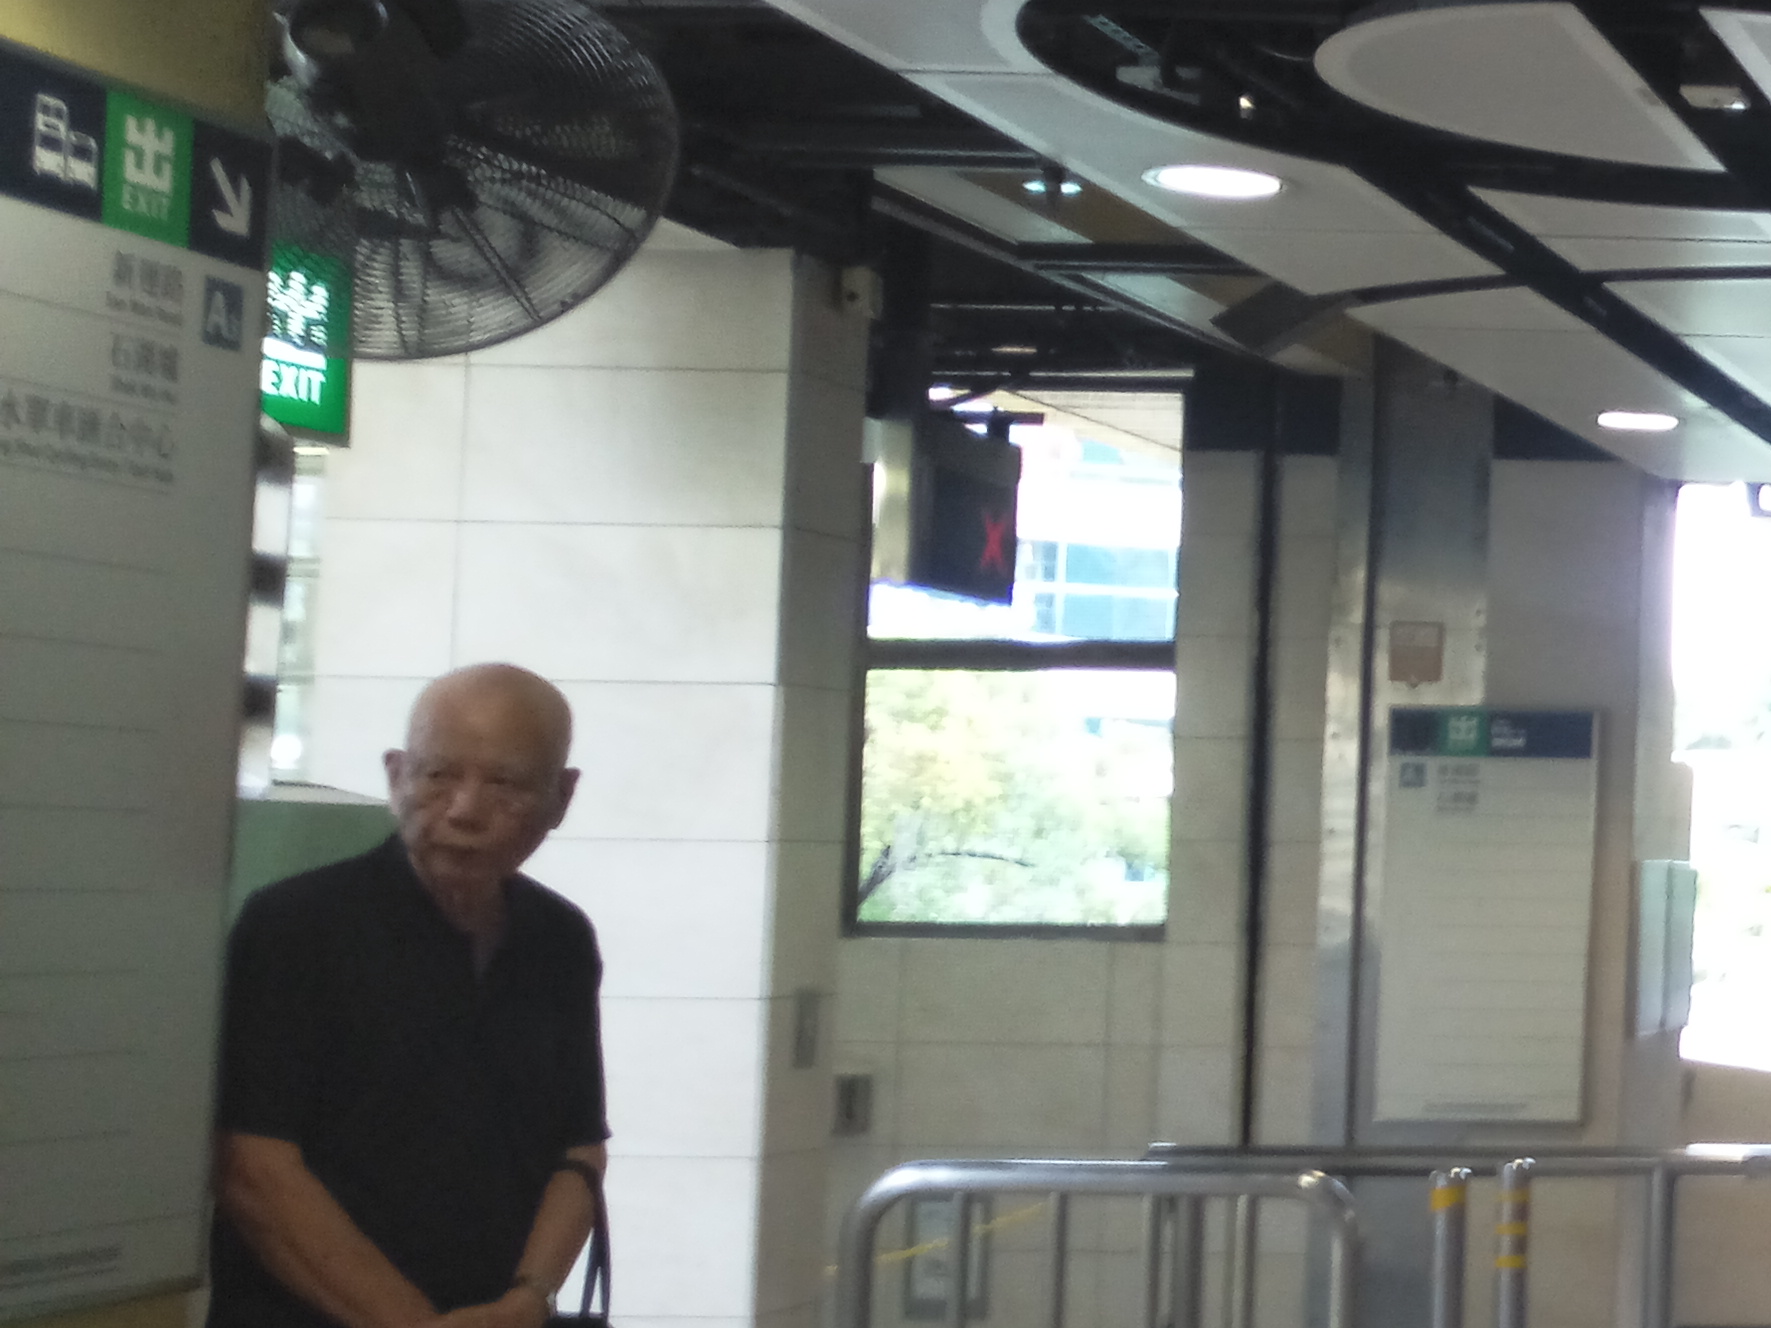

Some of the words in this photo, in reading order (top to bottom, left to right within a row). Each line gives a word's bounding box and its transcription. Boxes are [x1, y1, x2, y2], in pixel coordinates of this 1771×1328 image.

[123, 113, 175, 194] 出
[121, 181, 172, 222] EXIT
[260, 358, 327, 405] EXIT
